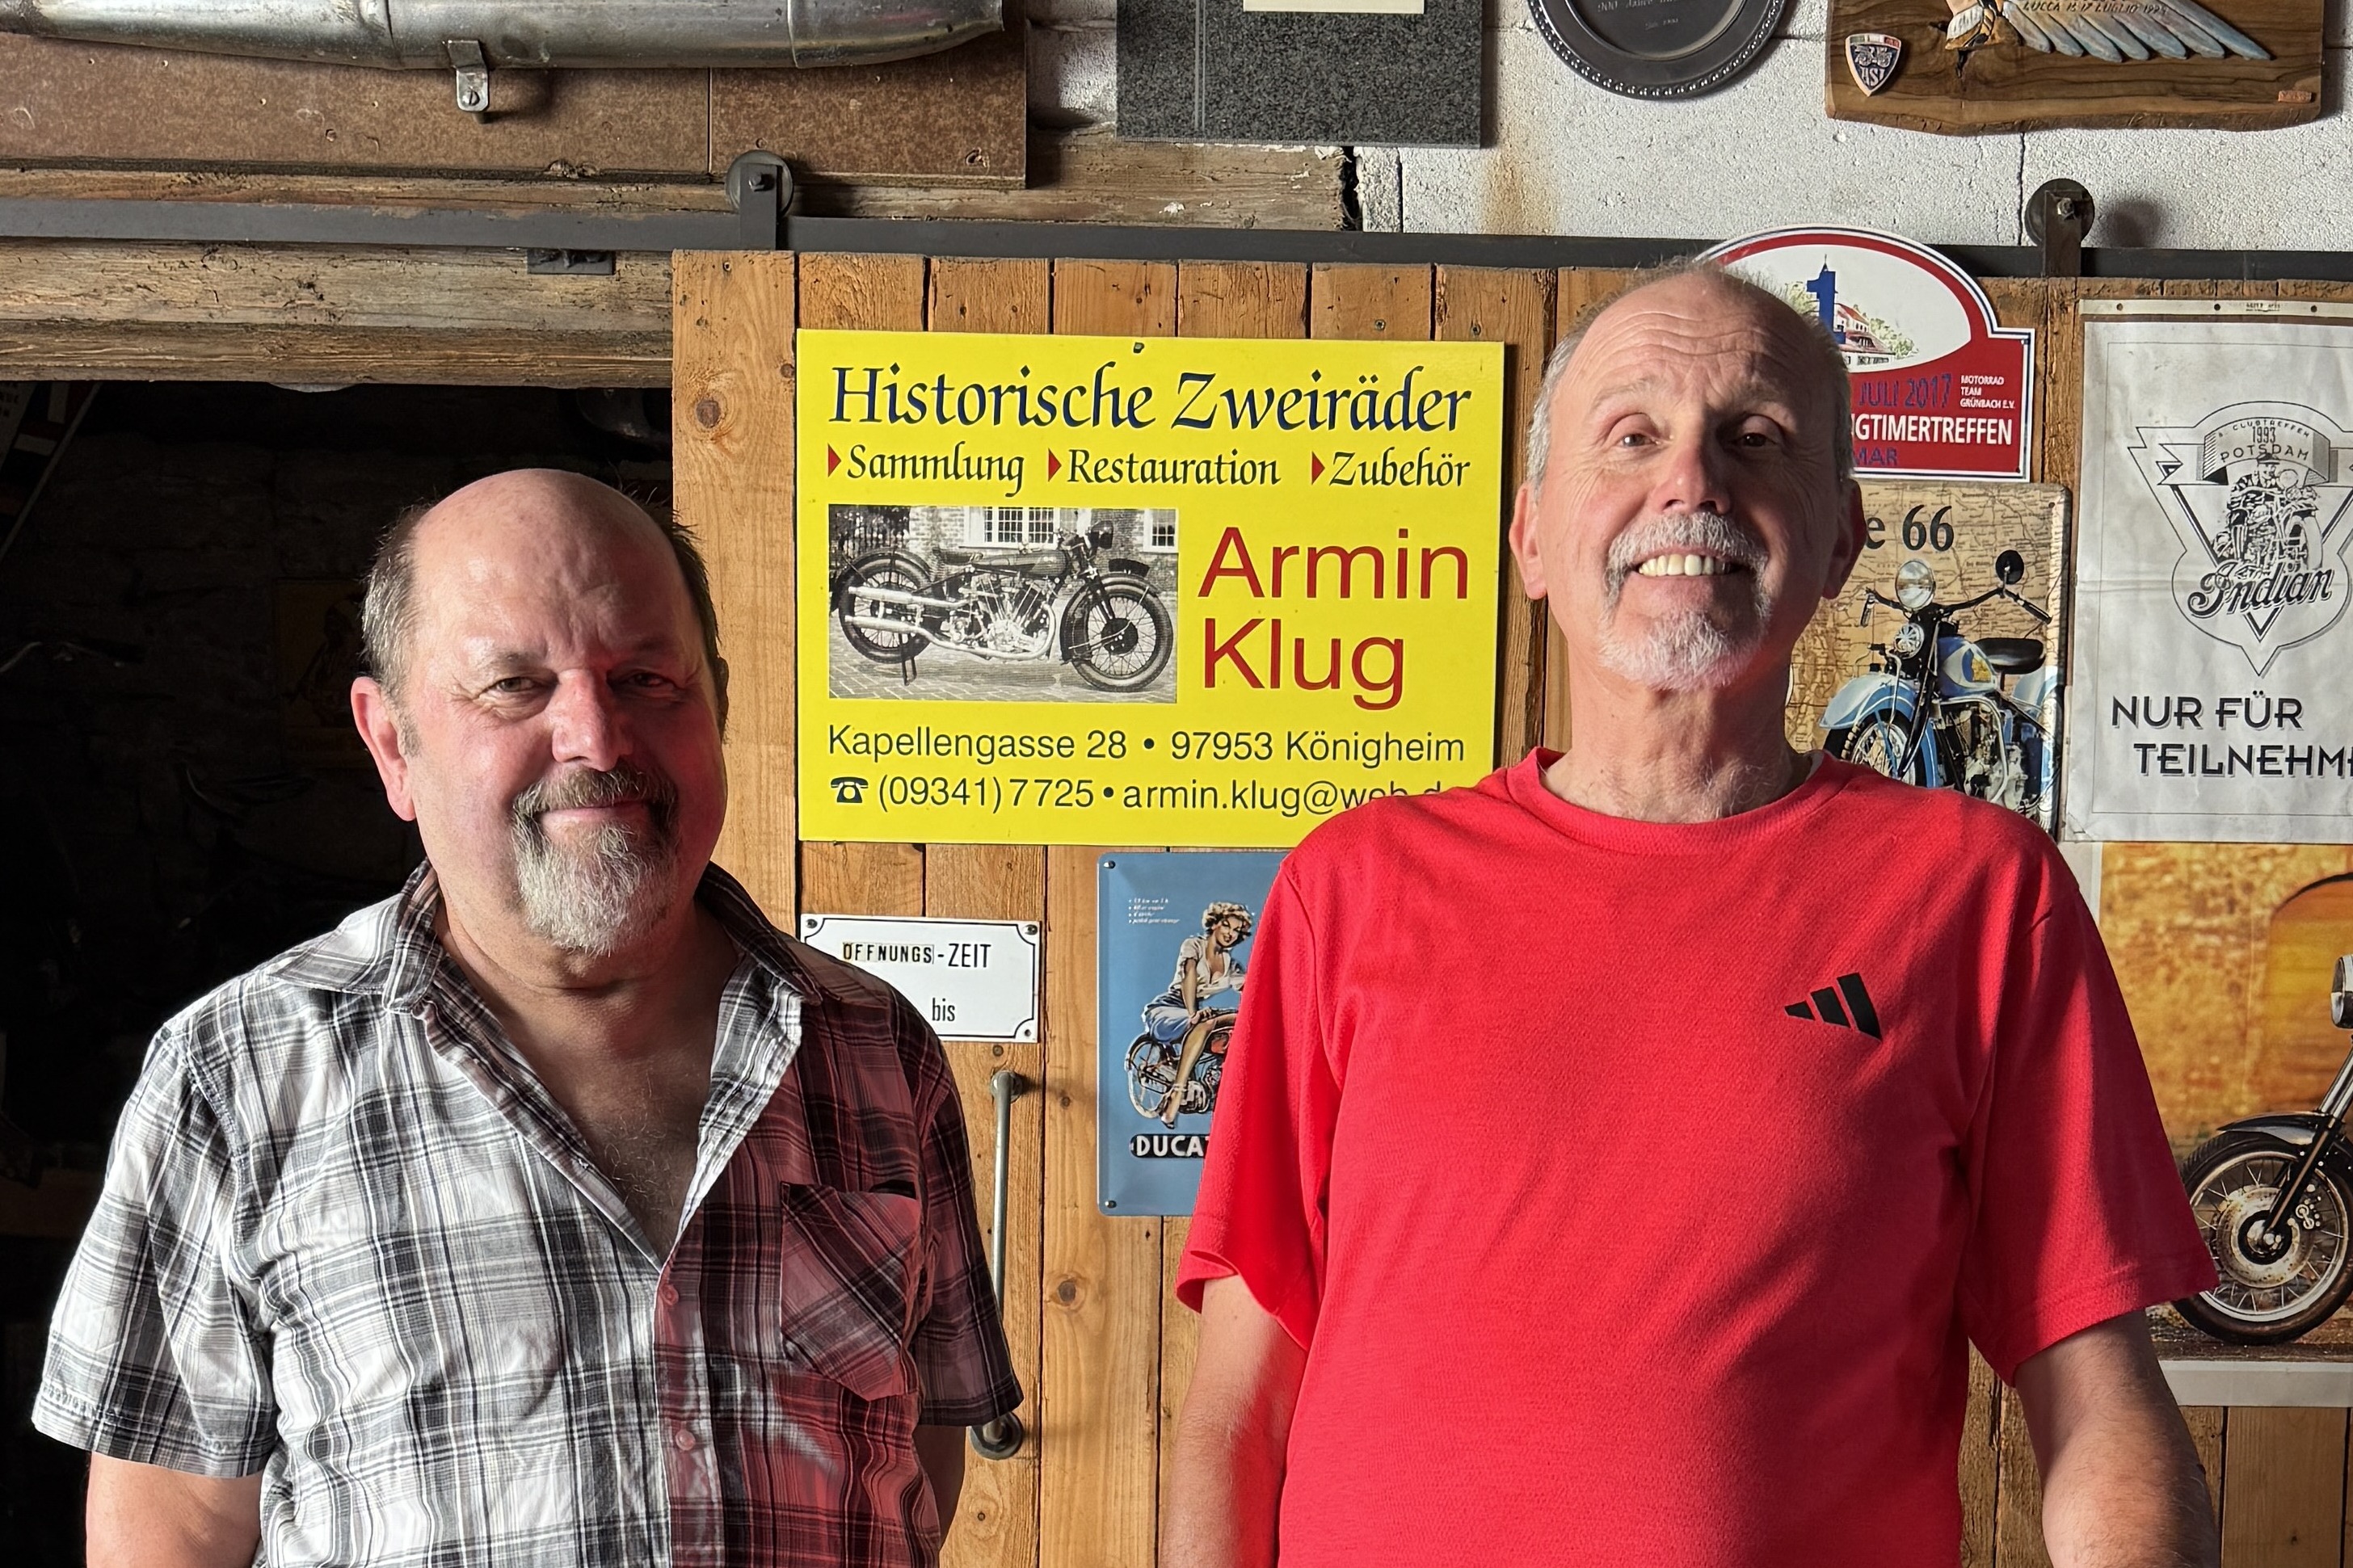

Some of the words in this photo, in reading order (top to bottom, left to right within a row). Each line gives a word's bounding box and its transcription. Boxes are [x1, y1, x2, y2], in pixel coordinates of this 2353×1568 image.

[2023, 2, 2060, 11] LUCCA
[828, 361, 1156, 429] Historische
[1171, 365, 1472, 431] Zweiräder
[1858, 380, 1899, 407] JULI
[1904, 373, 1952, 408] 2017
[1959, 375, 2005, 386] MOTORRAD
[1959, 386, 1982, 397] TEAM
[1959, 397, 2002, 409] GRÜNBACH
[2220, 443, 2309, 463] POTSDAM
[2252, 426, 2276, 443] 1993
[847, 440, 1025, 498] Sammlung
[1067, 448, 1282, 486] Restauration
[1328, 446, 1471, 486] Zubehör
[1901, 503, 1955, 552] 66
[1198, 526, 1468, 600] Armin
[2187, 560, 2334, 619] Indian
[1204, 618, 1404, 711] Klug
[2111, 696, 2204, 729] NUR
[2215, 690, 2304, 730] FÜR
[829, 724, 1075, 765] Kapellengasse
[1087, 729, 1127, 759] 28
[1171, 731, 1273, 760] 97953
[1287, 730, 1464, 769] Königheim
[932, 997, 956, 1022] bis
